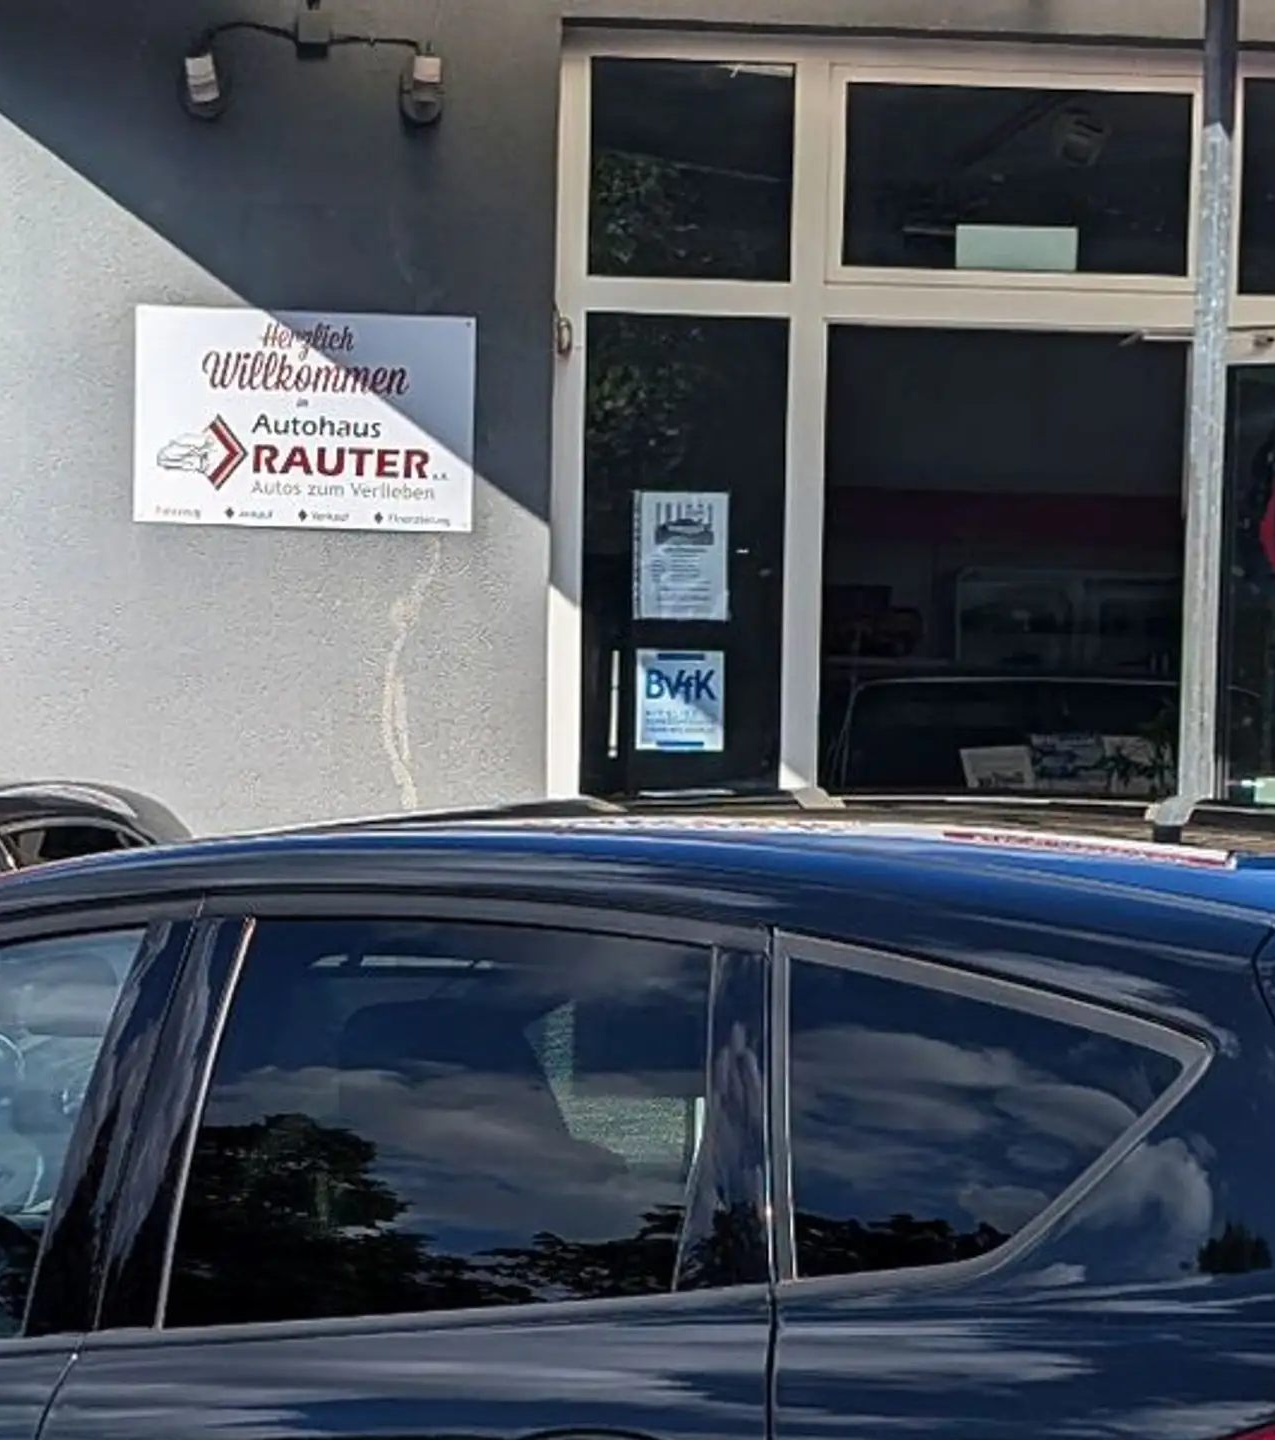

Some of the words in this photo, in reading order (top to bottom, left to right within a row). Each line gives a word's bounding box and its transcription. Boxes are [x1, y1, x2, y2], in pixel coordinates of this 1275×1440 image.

[258, 322, 355, 359] Herzlich
[202, 350, 410, 396] Willkommen
[251, 413, 382, 438] Autohaus
[252, 444, 430, 479] RAUTER
[251, 480, 302, 496] Autos
[307, 483, 344, 497] zum
[350, 483, 436, 501] Verlieben
